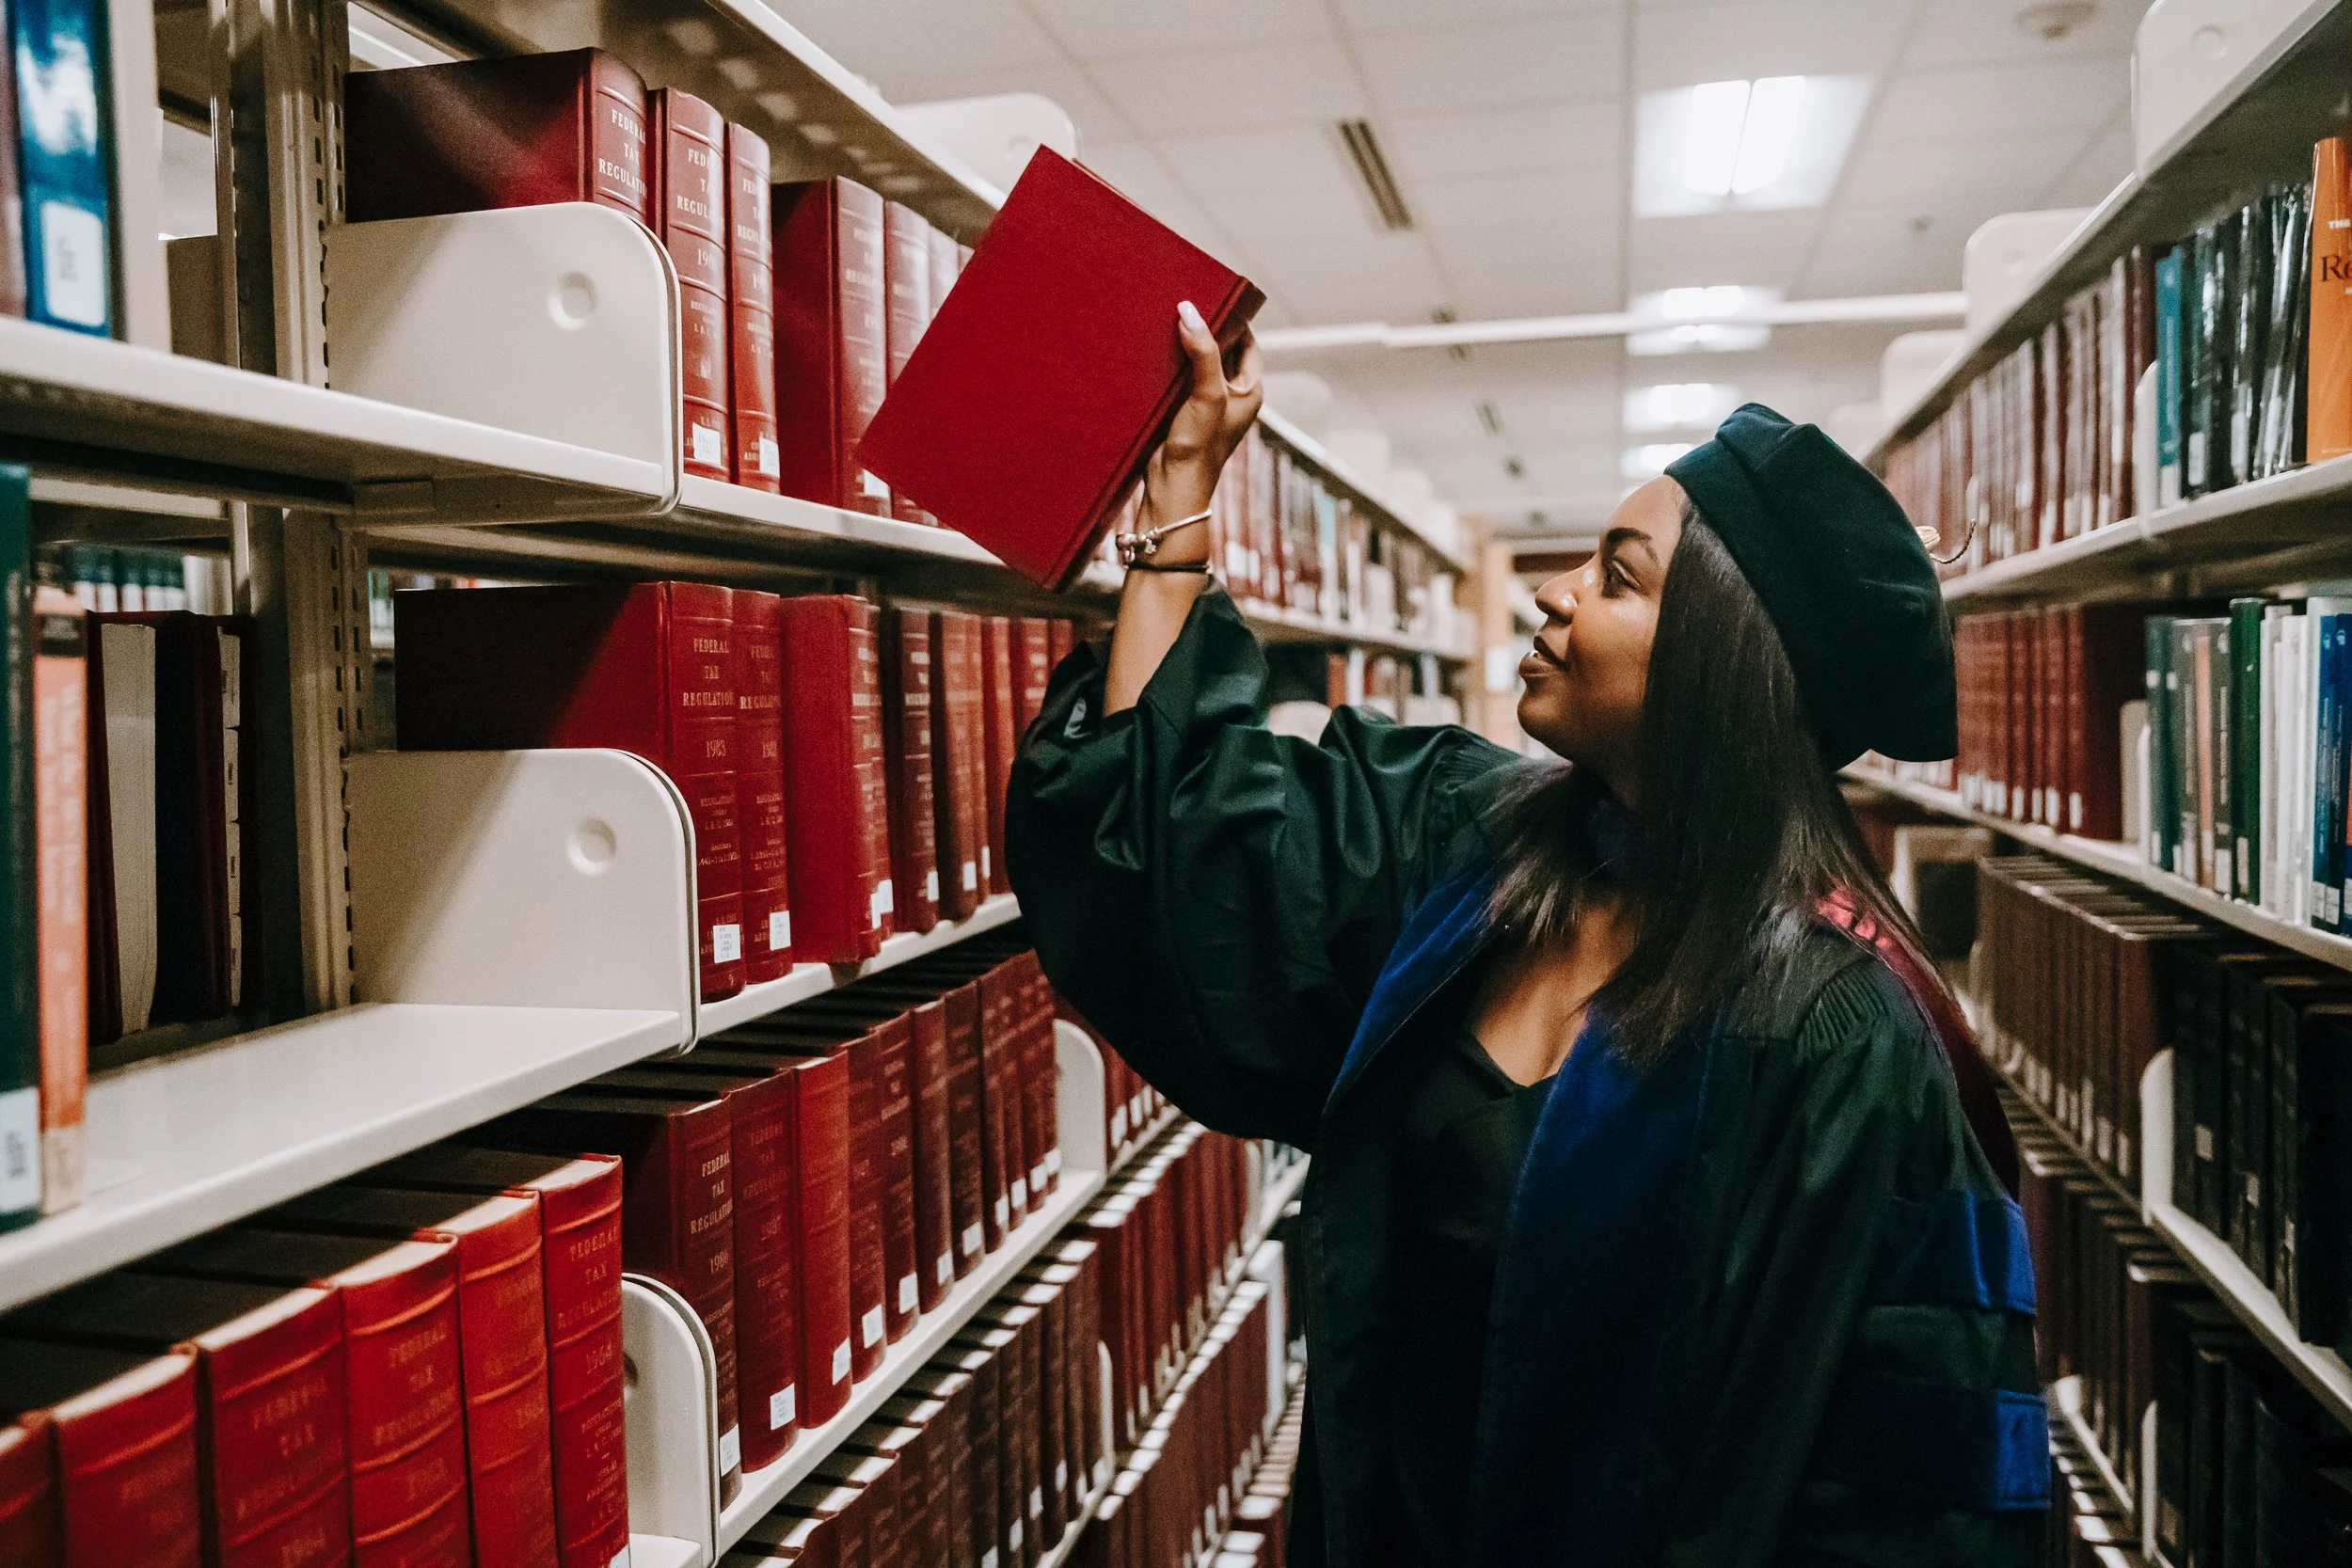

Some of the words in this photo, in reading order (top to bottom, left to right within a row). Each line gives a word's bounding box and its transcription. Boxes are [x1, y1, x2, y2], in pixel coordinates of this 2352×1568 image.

[693, 639, 730, 653] FEDERAL
[704, 665, 720, 679] TAX
[702, 1150, 731, 1178] FEDERAL
[712, 1179, 725, 1198] TAX
[585, 1261, 608, 1285] TAX
